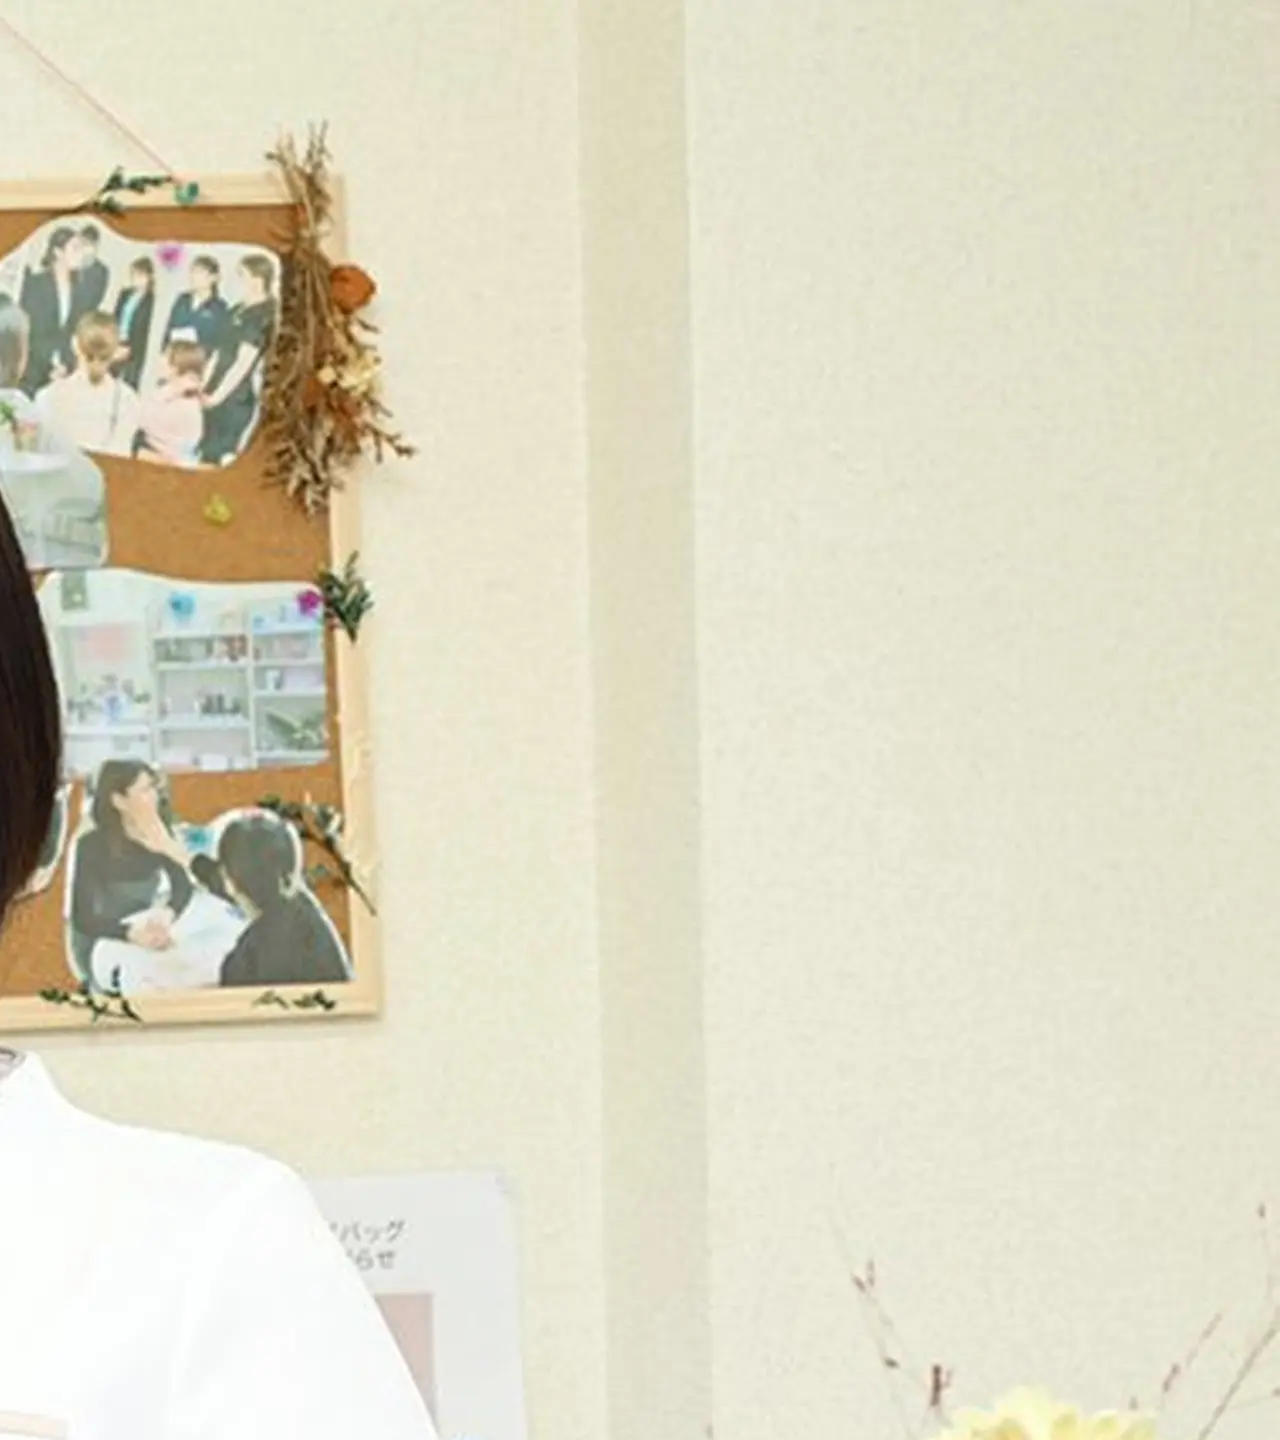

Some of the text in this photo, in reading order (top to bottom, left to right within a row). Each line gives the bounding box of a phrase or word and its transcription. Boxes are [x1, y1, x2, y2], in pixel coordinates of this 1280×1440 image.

[328, 1218, 405, 1245] バッグ
[345, 1247, 396, 1272] らせ
